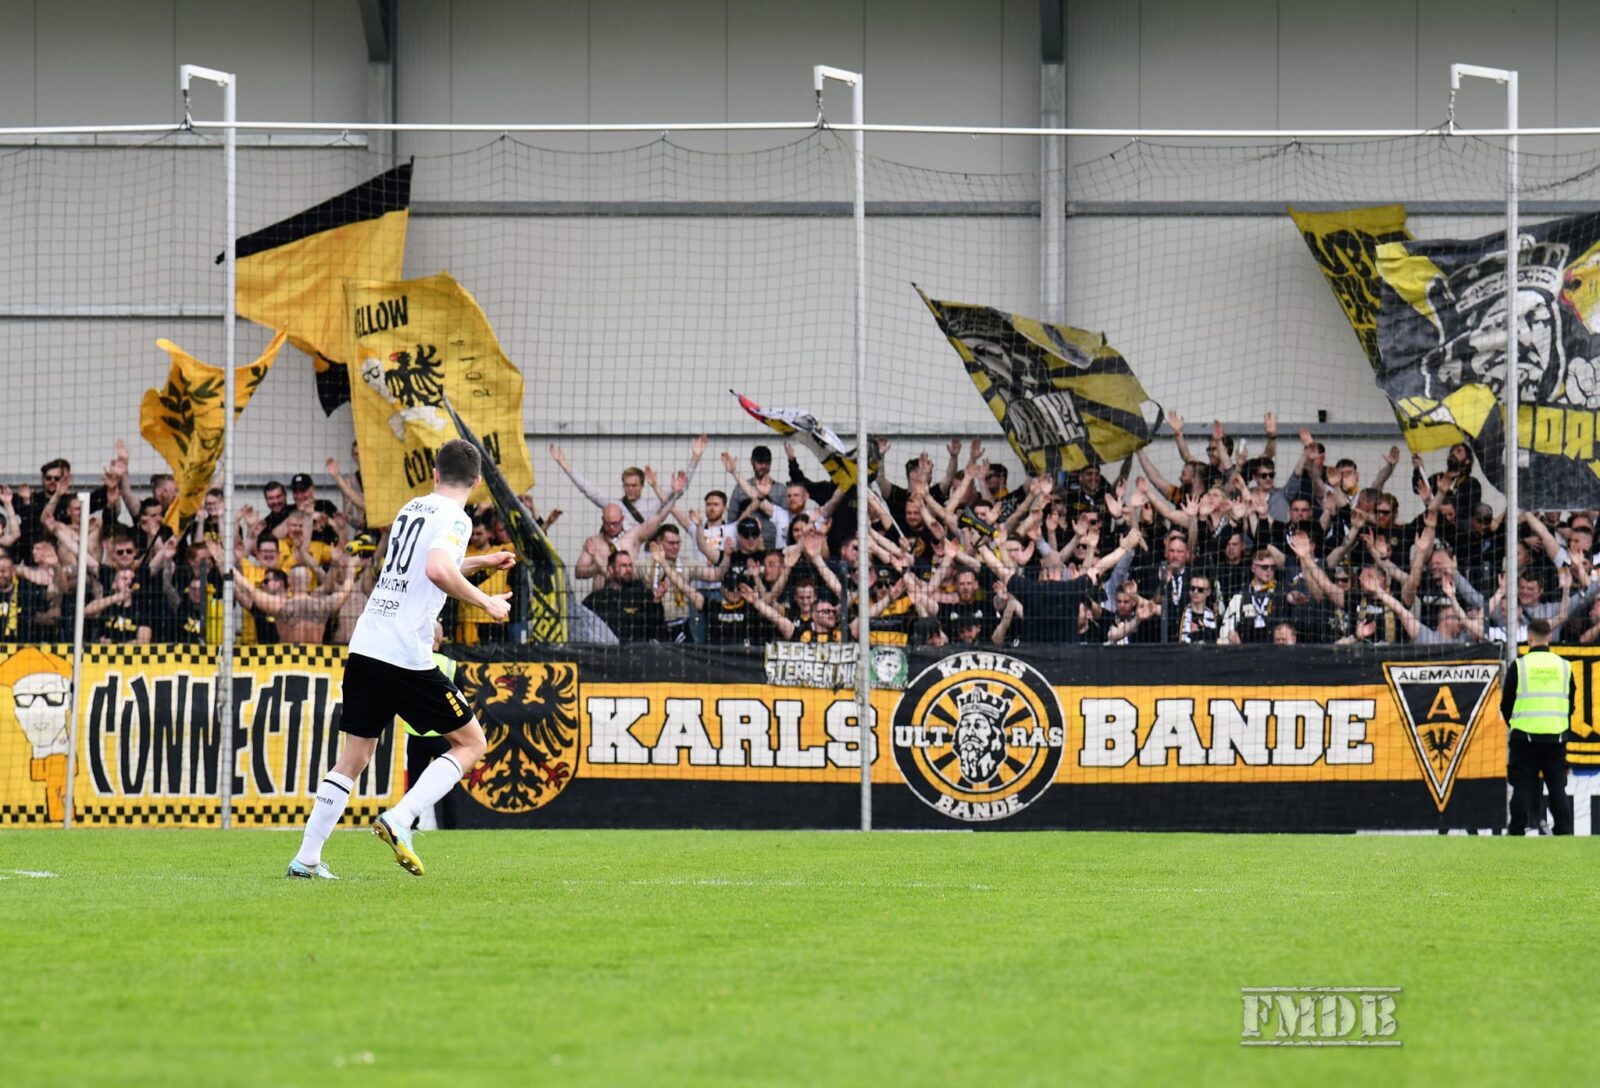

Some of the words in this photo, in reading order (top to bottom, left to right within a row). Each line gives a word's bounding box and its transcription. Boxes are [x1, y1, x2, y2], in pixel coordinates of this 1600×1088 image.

[354, 294, 408, 339] ELLOW
[386, 514, 426, 575] 30
[937, 654, 1026, 679] KARLS
[1398, 669, 1491, 681] ALEMANNIA
[1427, 684, 1461, 720] A
[88, 672, 394, 797] CONNECTIN
[587, 697, 879, 768] KARLS
[1079, 698, 1376, 768] BANDE
[934, 794, 1024, 819] BANDE
